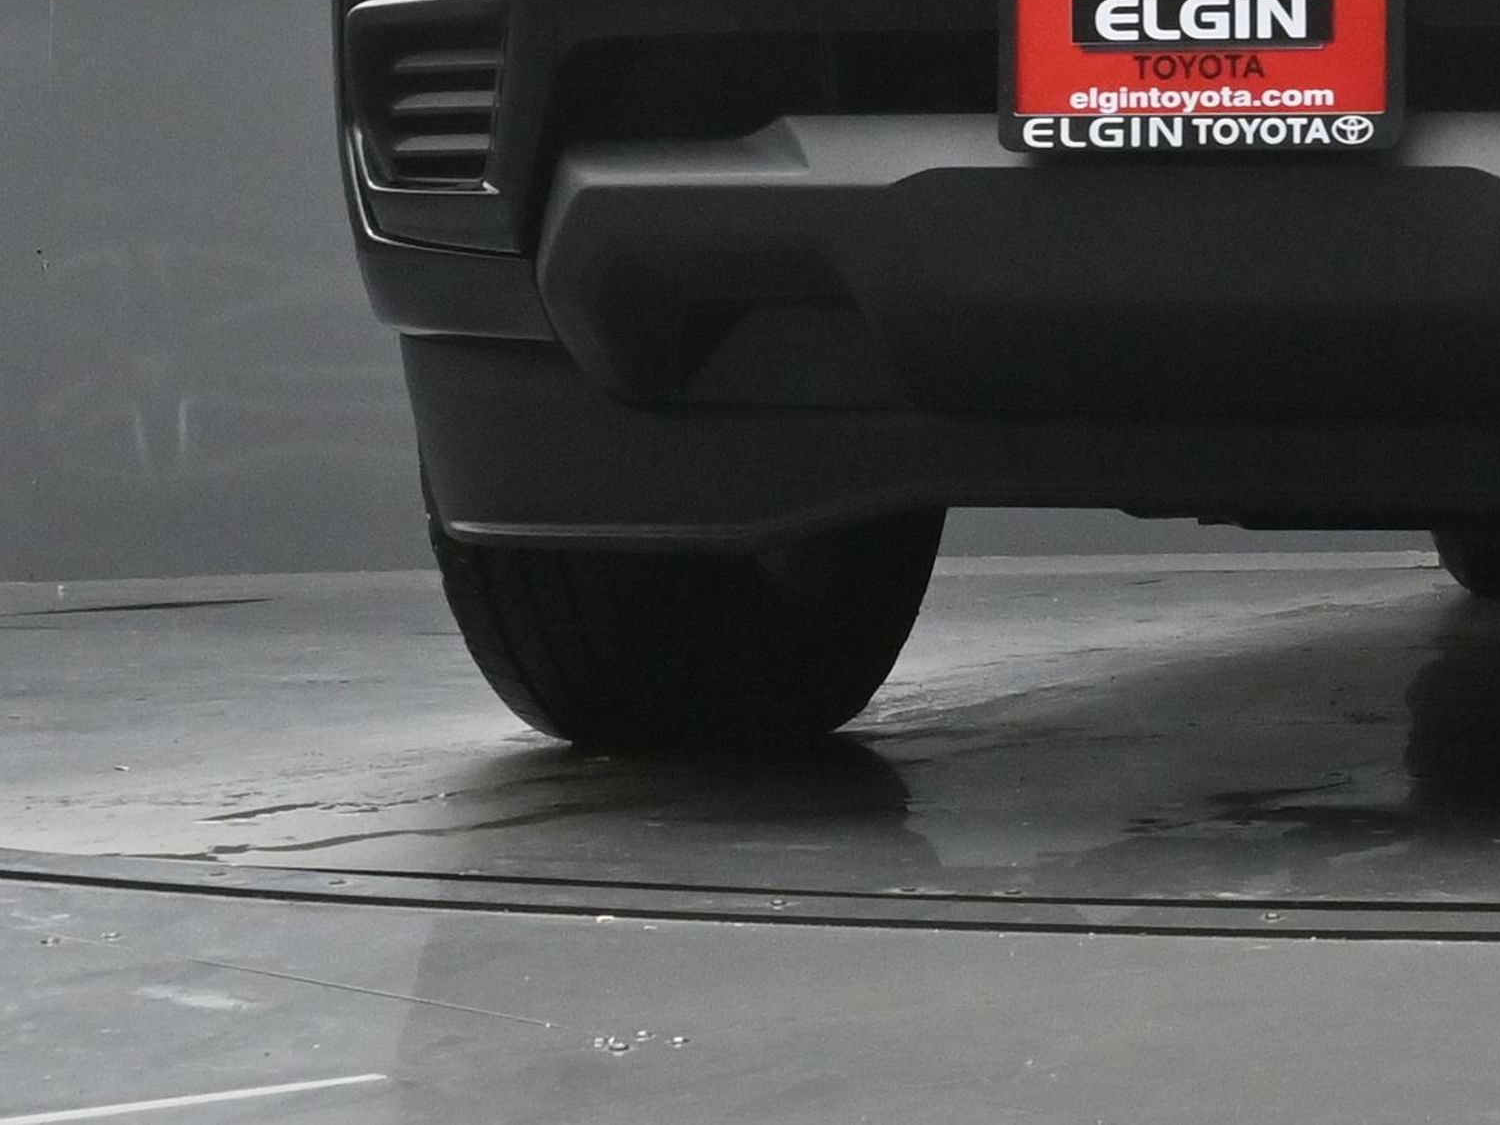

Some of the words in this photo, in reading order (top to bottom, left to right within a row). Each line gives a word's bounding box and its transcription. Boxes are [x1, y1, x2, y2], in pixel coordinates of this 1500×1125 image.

[1133, 53, 1266, 80] TOYOTA
[1069, 86, 1334, 114] elgintoyota.com
[1022, 117, 1184, 148] ELGIN
[1191, 117, 1332, 146] TOYOTA
